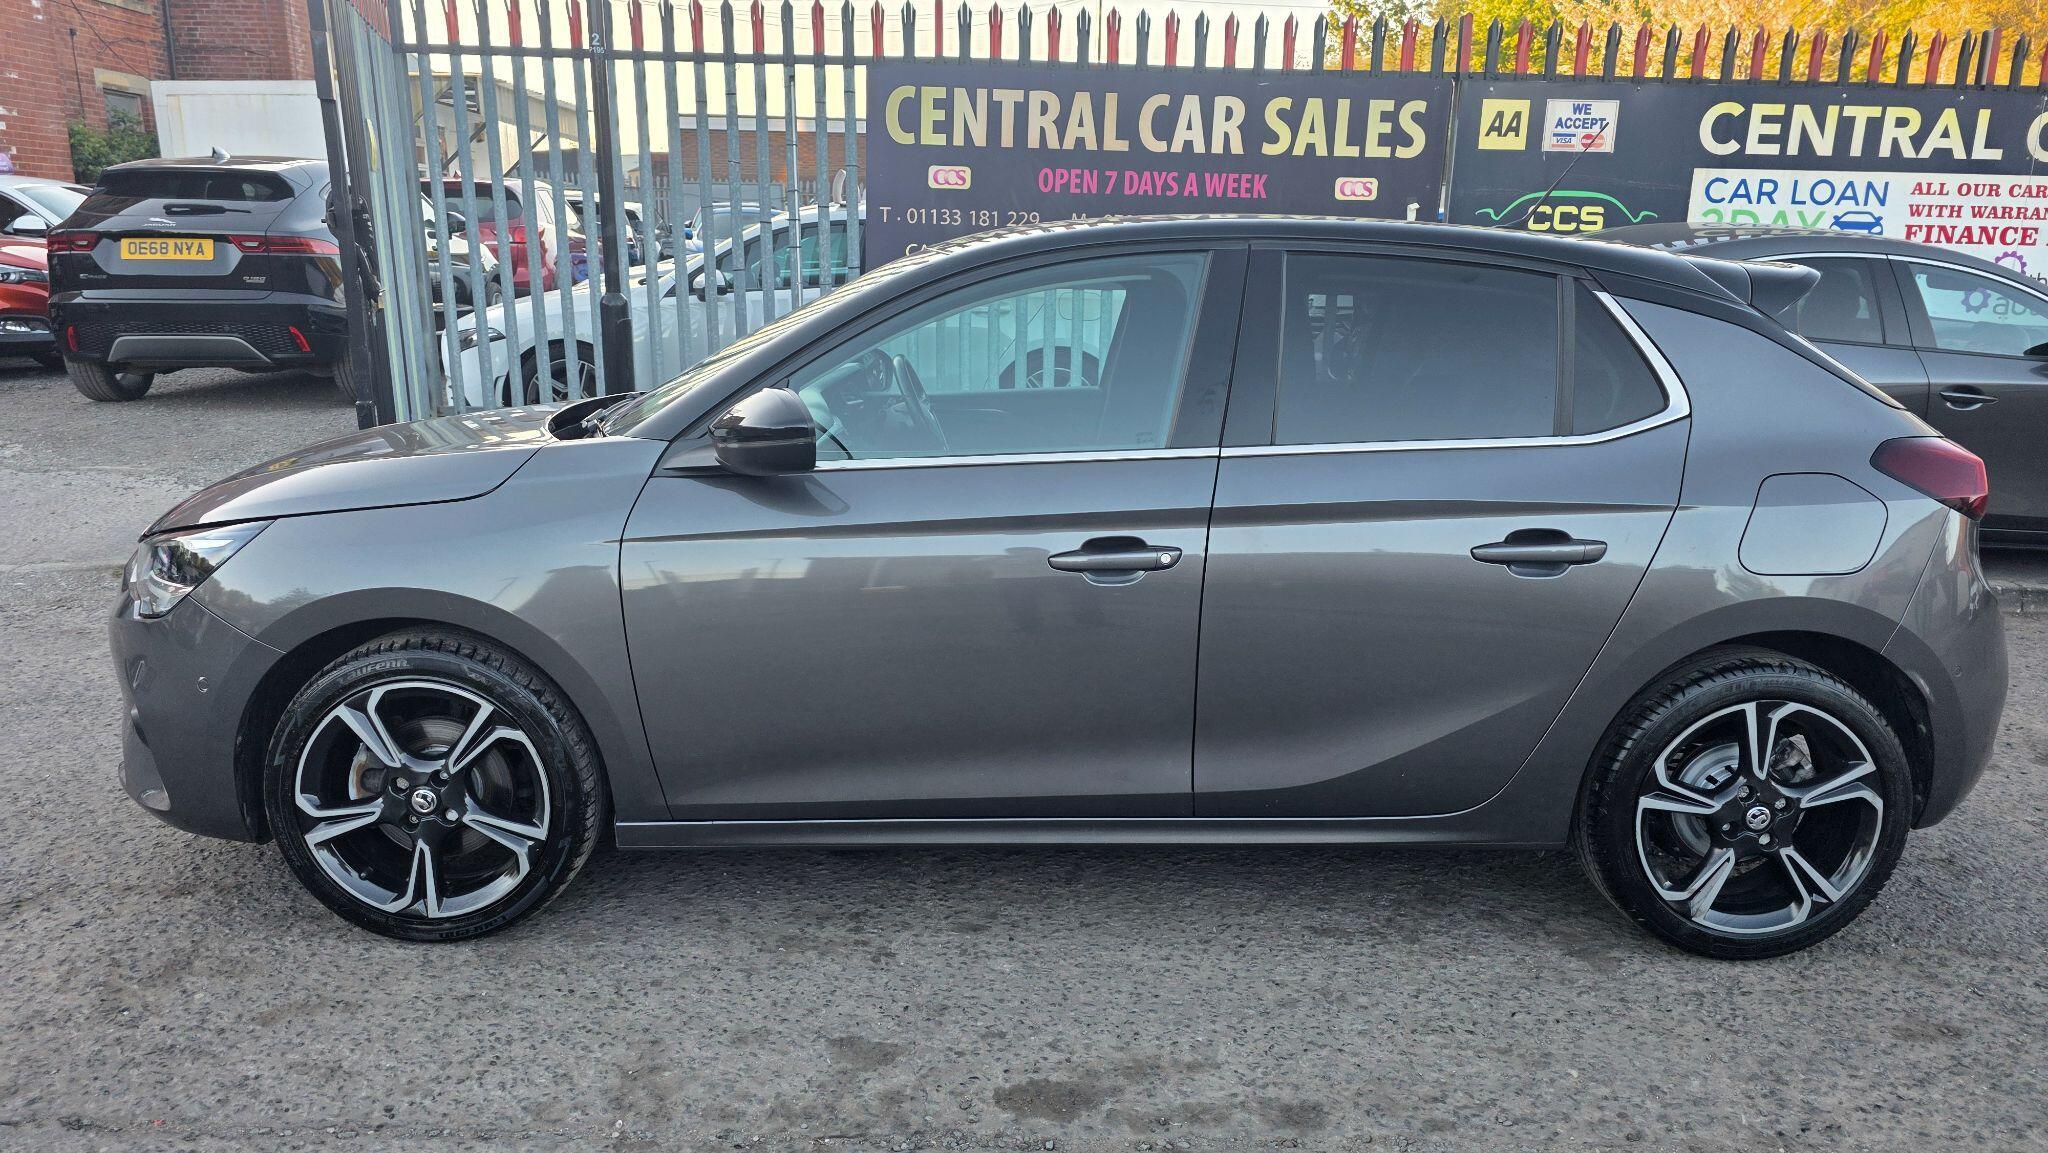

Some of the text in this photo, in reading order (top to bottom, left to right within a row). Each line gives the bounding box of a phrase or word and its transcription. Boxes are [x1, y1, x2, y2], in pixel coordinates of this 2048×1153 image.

[591, 32, 600, 46] 2
[1572, 103, 1593, 116] WE
[885, 85, 1428, 159] CENTRAL CAR SALES
[1484, 110, 1523, 138] AA
[1554, 117, 1607, 131] ACCEPT
[1699, 101, 2004, 161] CENTRAL
[933, 168, 967, 186] CCS
[1038, 167, 1269, 199] OPEN 7 DAYS A WEEK
[1339, 180, 1373, 197] CCS
[1704, 177, 1890, 207] CAR LOAN
[1910, 182, 2048, 199] ALL OUR CAR
[906, 207, 962, 226] 01133
[969, 210, 998, 227] 181
[1006, 210, 1041, 227] 229
[1527, 205, 1605, 232] CCS
[1908, 204, 1965, 219] WITH
[1904, 224, 2040, 247] FINANCE
[127, 241, 206, 256] OE68 NYA
